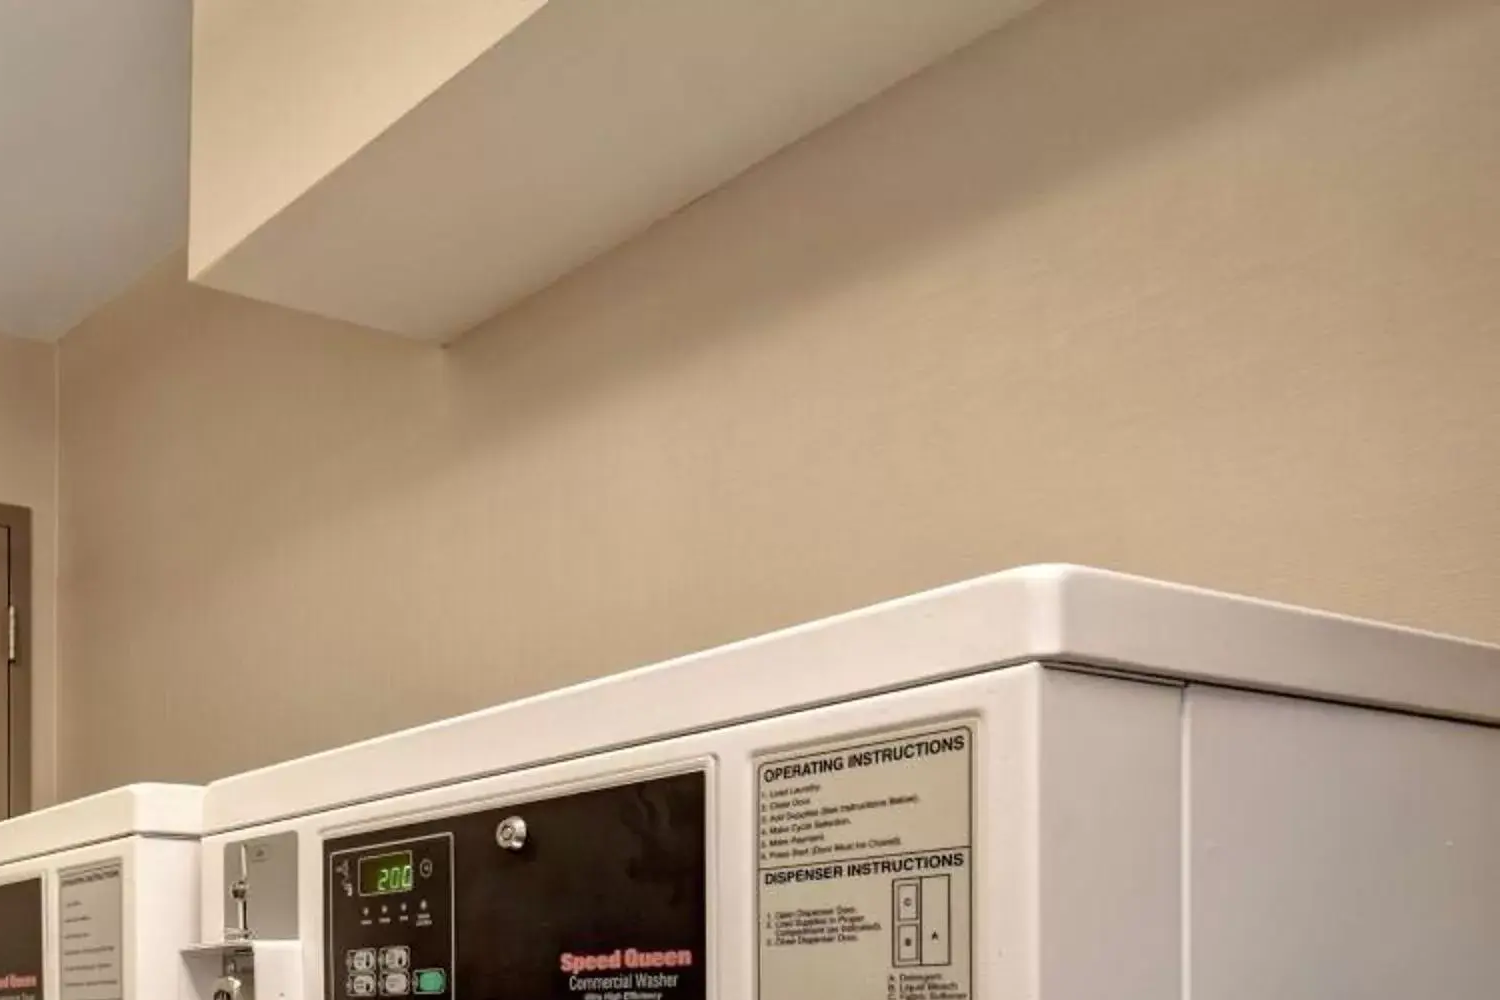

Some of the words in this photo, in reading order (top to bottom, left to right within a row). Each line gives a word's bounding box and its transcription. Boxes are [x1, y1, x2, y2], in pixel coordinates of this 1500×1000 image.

[763, 757, 844, 783] OPERATING
[848, 735, 965, 767] INSTRUCTIONS
[764, 864, 843, 885] DISPENSER
[848, 852, 965, 876] INSTRUCTIONS
[931, 930, 939, 940] A
[560, 949, 621, 974] Speed
[624, 947, 692, 969] Queen
[569, 974, 633, 991] Commercial
[635, 972, 679, 988] Washer
